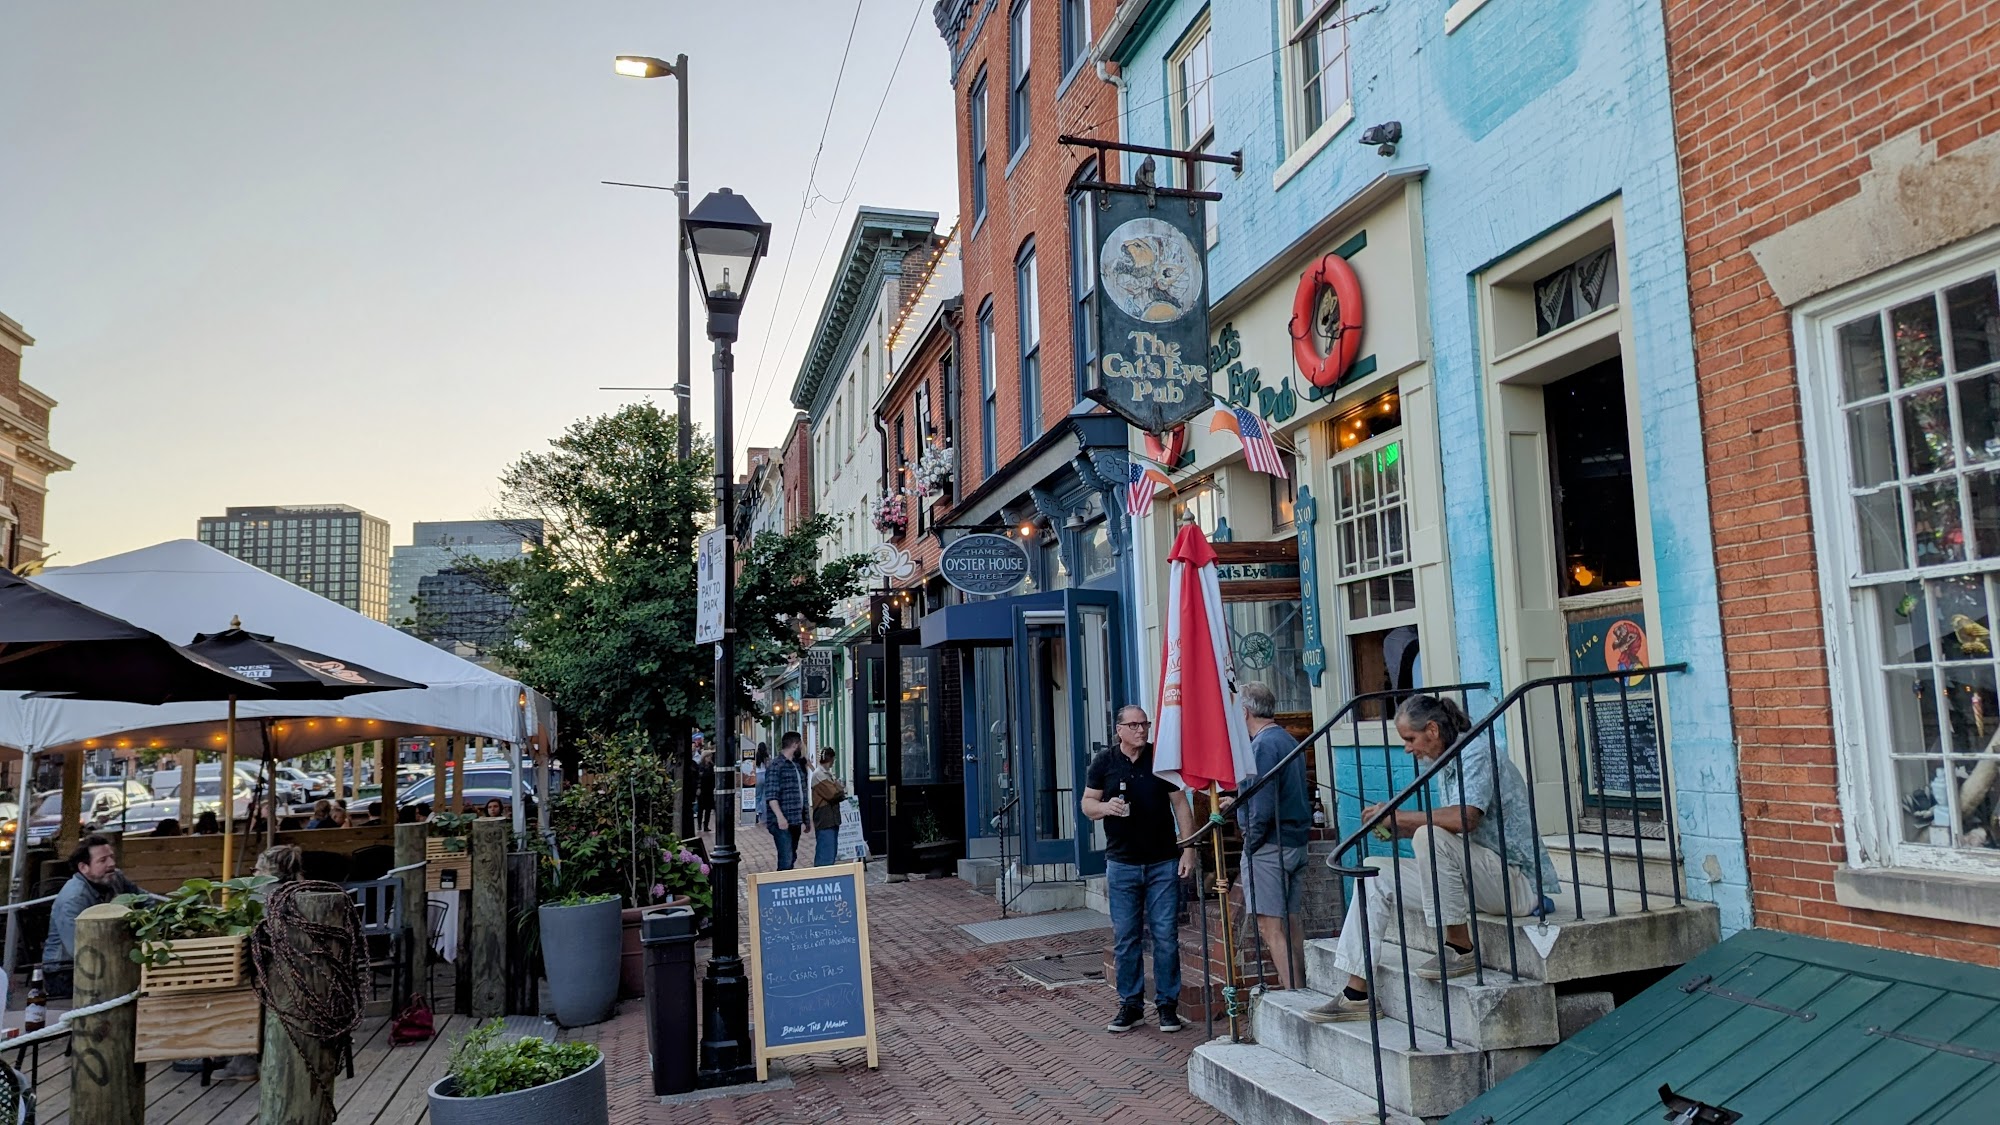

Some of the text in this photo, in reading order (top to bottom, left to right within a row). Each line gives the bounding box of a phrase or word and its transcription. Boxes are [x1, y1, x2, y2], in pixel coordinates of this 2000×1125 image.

[1128, 331, 1181, 357] The
[1102, 353, 1208, 386] Cat's Eye
[1131, 379, 1184, 403] Pub
[1226, 361, 1261, 407] Eye
[1258, 376, 1297, 422] Pub
[945, 557, 1024, 571] OYSTER HOUSE
[1217, 565, 1241, 580] at's
[1242, 564, 1268, 579] Eye
[967, 572, 1005, 580] STREET
[701, 581, 721, 599] PAY TO
[703, 597, 719, 614] PARK
[809, 651, 830, 659] AILY
[1575, 634, 1599, 659] Live
[228, 663, 271, 672] NNESS
[844, 811, 860, 823] NCH
[772, 894, 842, 907] SMALL BATCH TEQUILA
